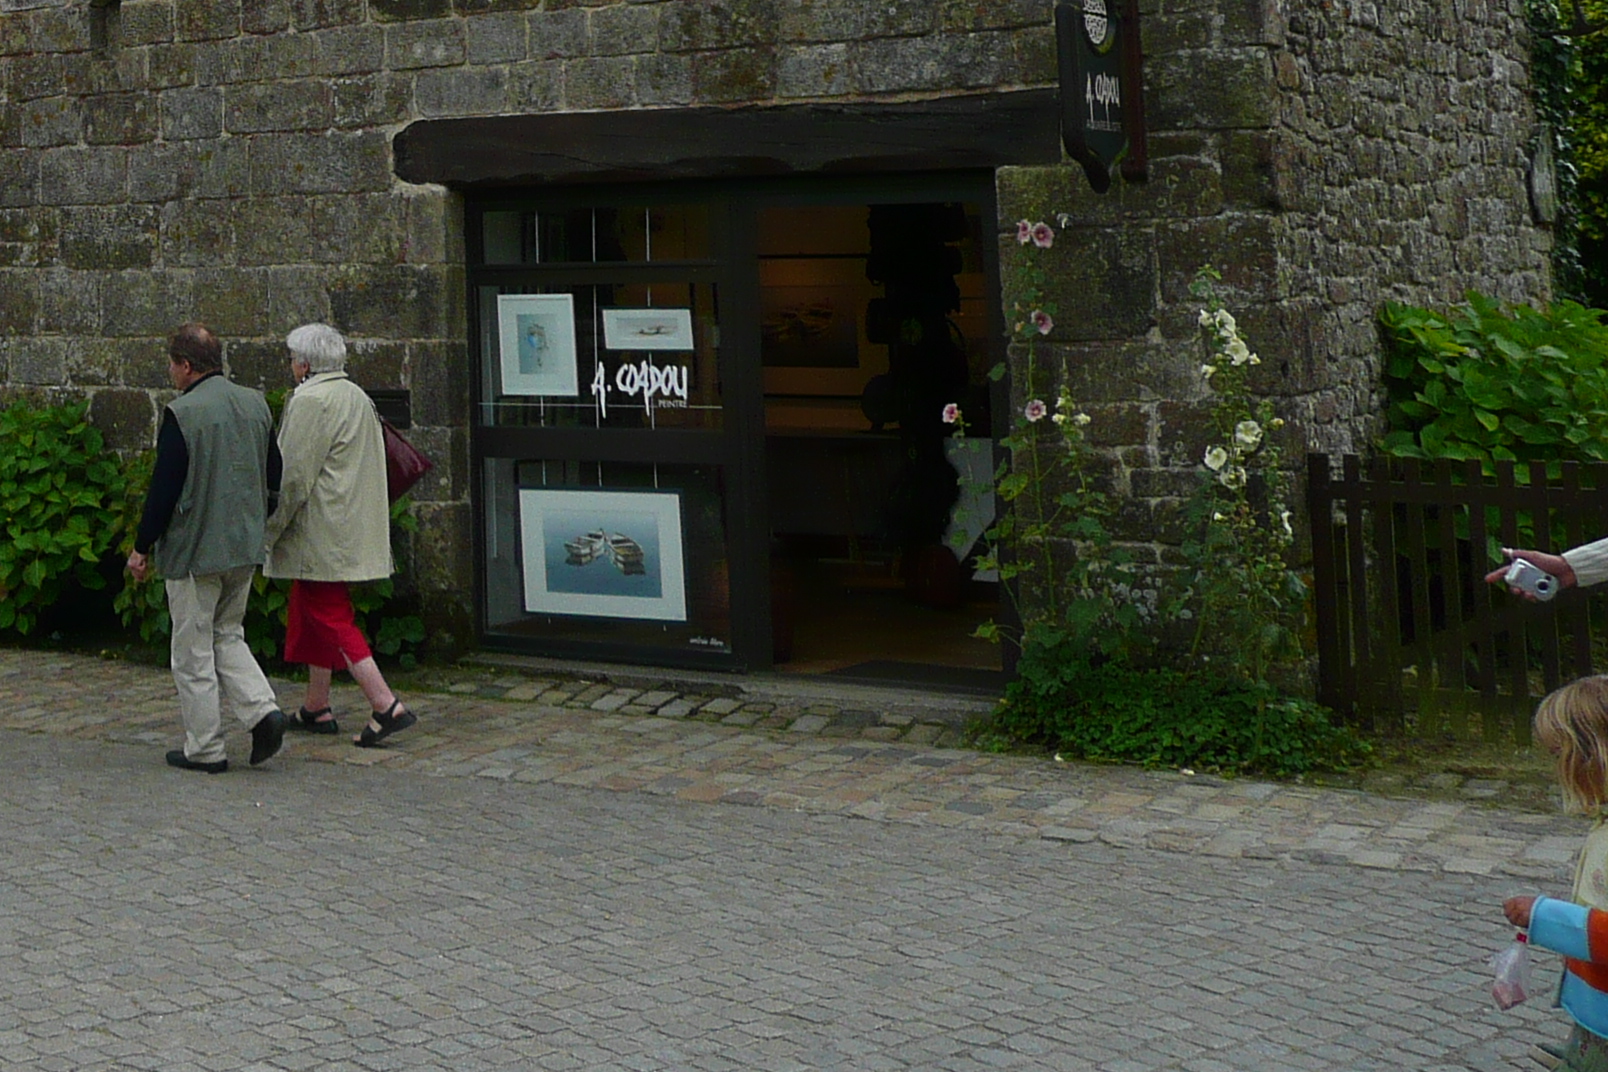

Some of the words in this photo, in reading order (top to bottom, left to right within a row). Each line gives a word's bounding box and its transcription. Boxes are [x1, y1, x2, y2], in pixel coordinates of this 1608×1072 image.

[590, 360, 612, 419] A.
[615, 359, 688, 418] COADOU
[658, 399, 688, 409] PEINTRE
